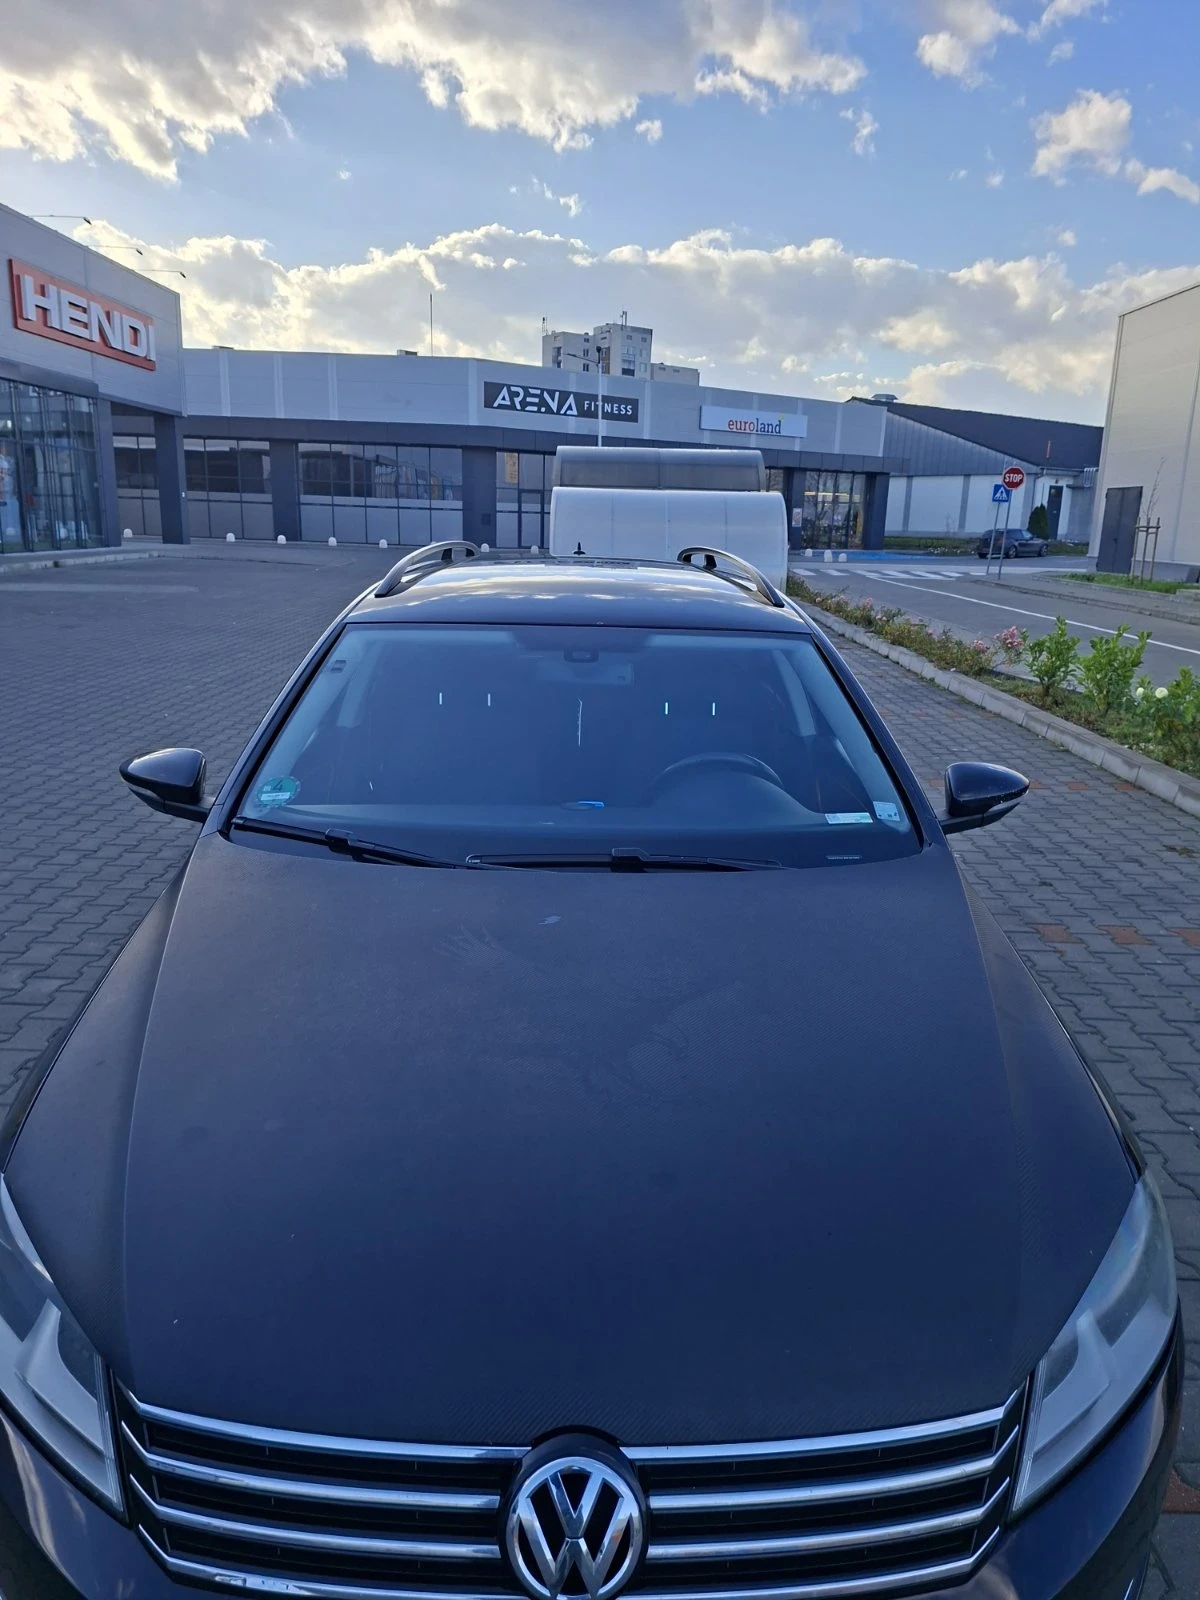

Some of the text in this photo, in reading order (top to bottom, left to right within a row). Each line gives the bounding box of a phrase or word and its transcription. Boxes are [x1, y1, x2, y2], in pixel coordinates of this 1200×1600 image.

[21, 274, 156, 362] HENDI
[492, 385, 578, 416] ARENA
[728, 417, 781, 434] euroland
[1004, 473, 1023, 482] STOP
